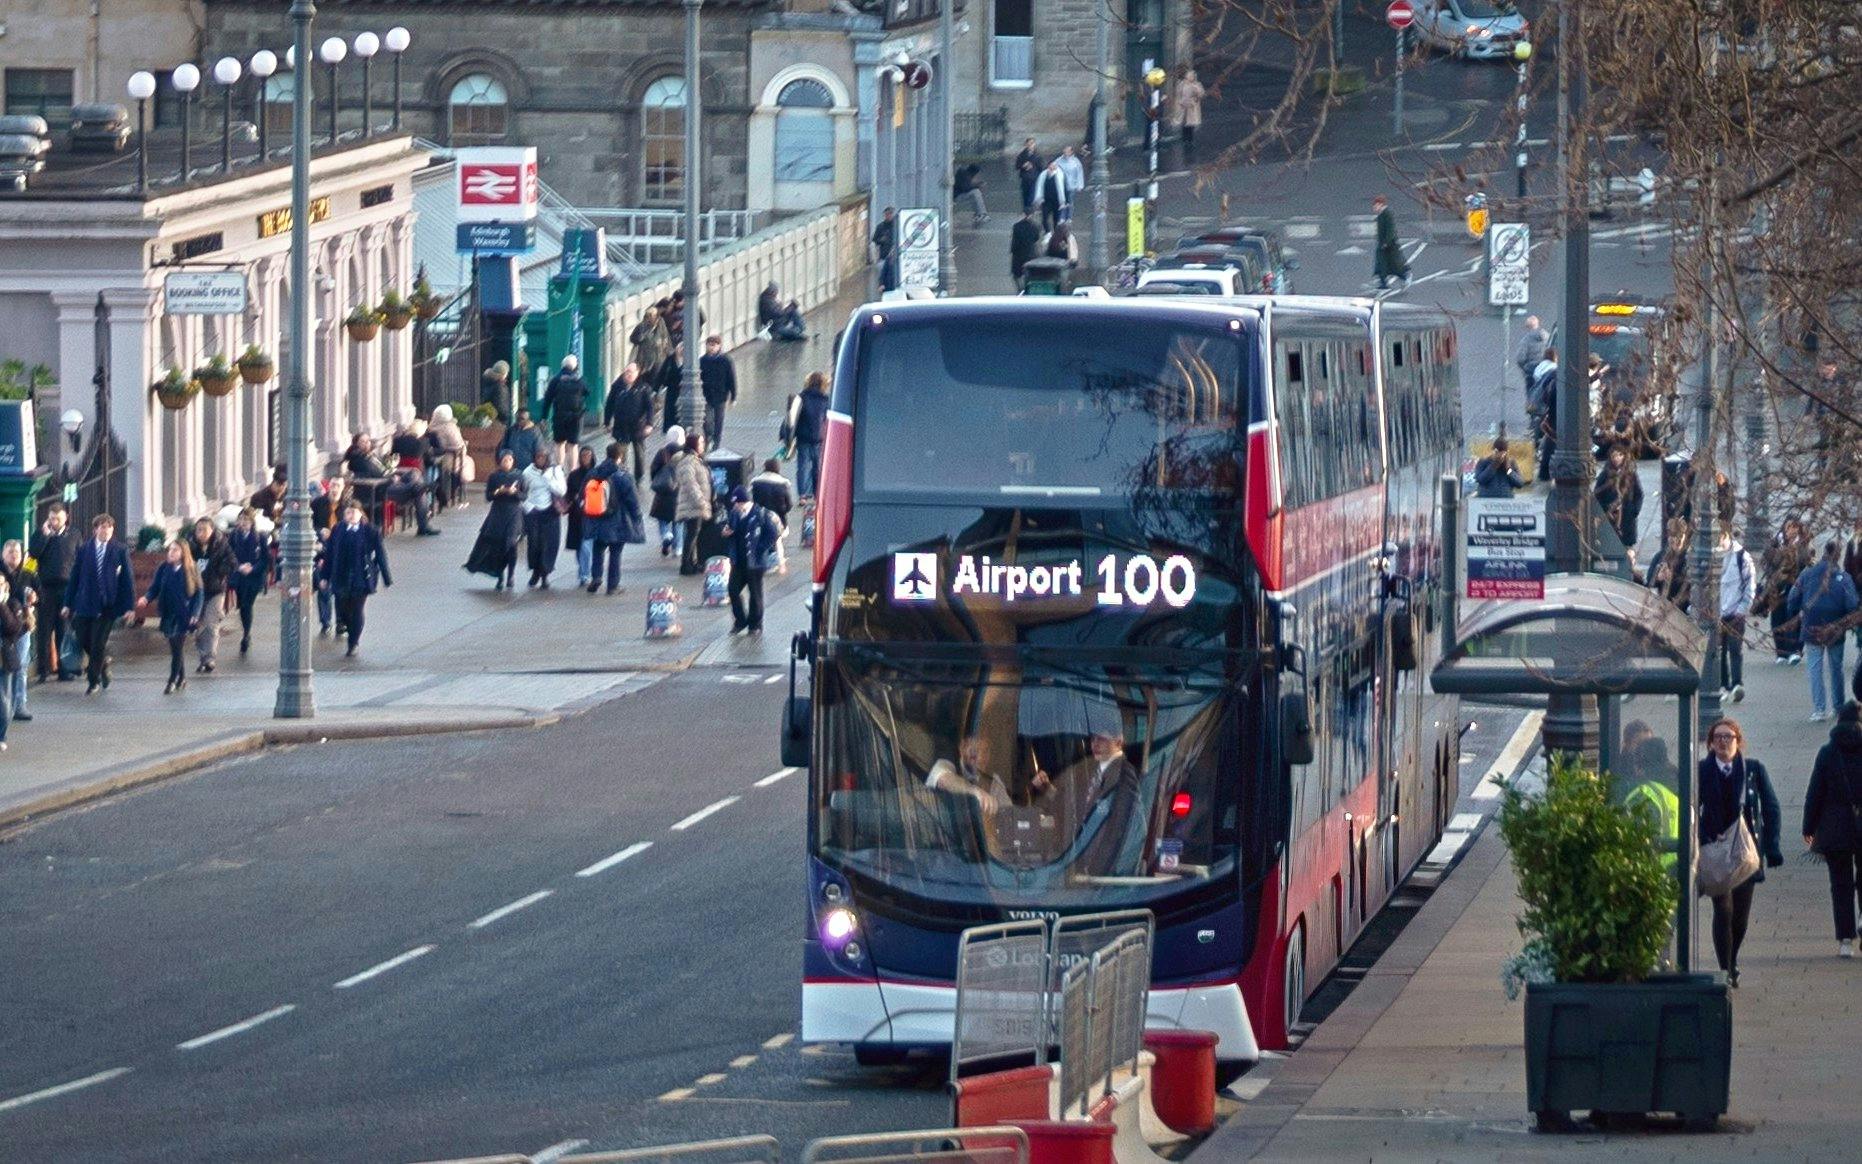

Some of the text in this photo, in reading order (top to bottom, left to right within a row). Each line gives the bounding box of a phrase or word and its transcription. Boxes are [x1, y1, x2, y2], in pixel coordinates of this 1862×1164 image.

[169, 287, 241, 298] BOOKING OFFICE
[952, 554, 1196, 607] Airport 100
[648, 602, 674, 619] 900
